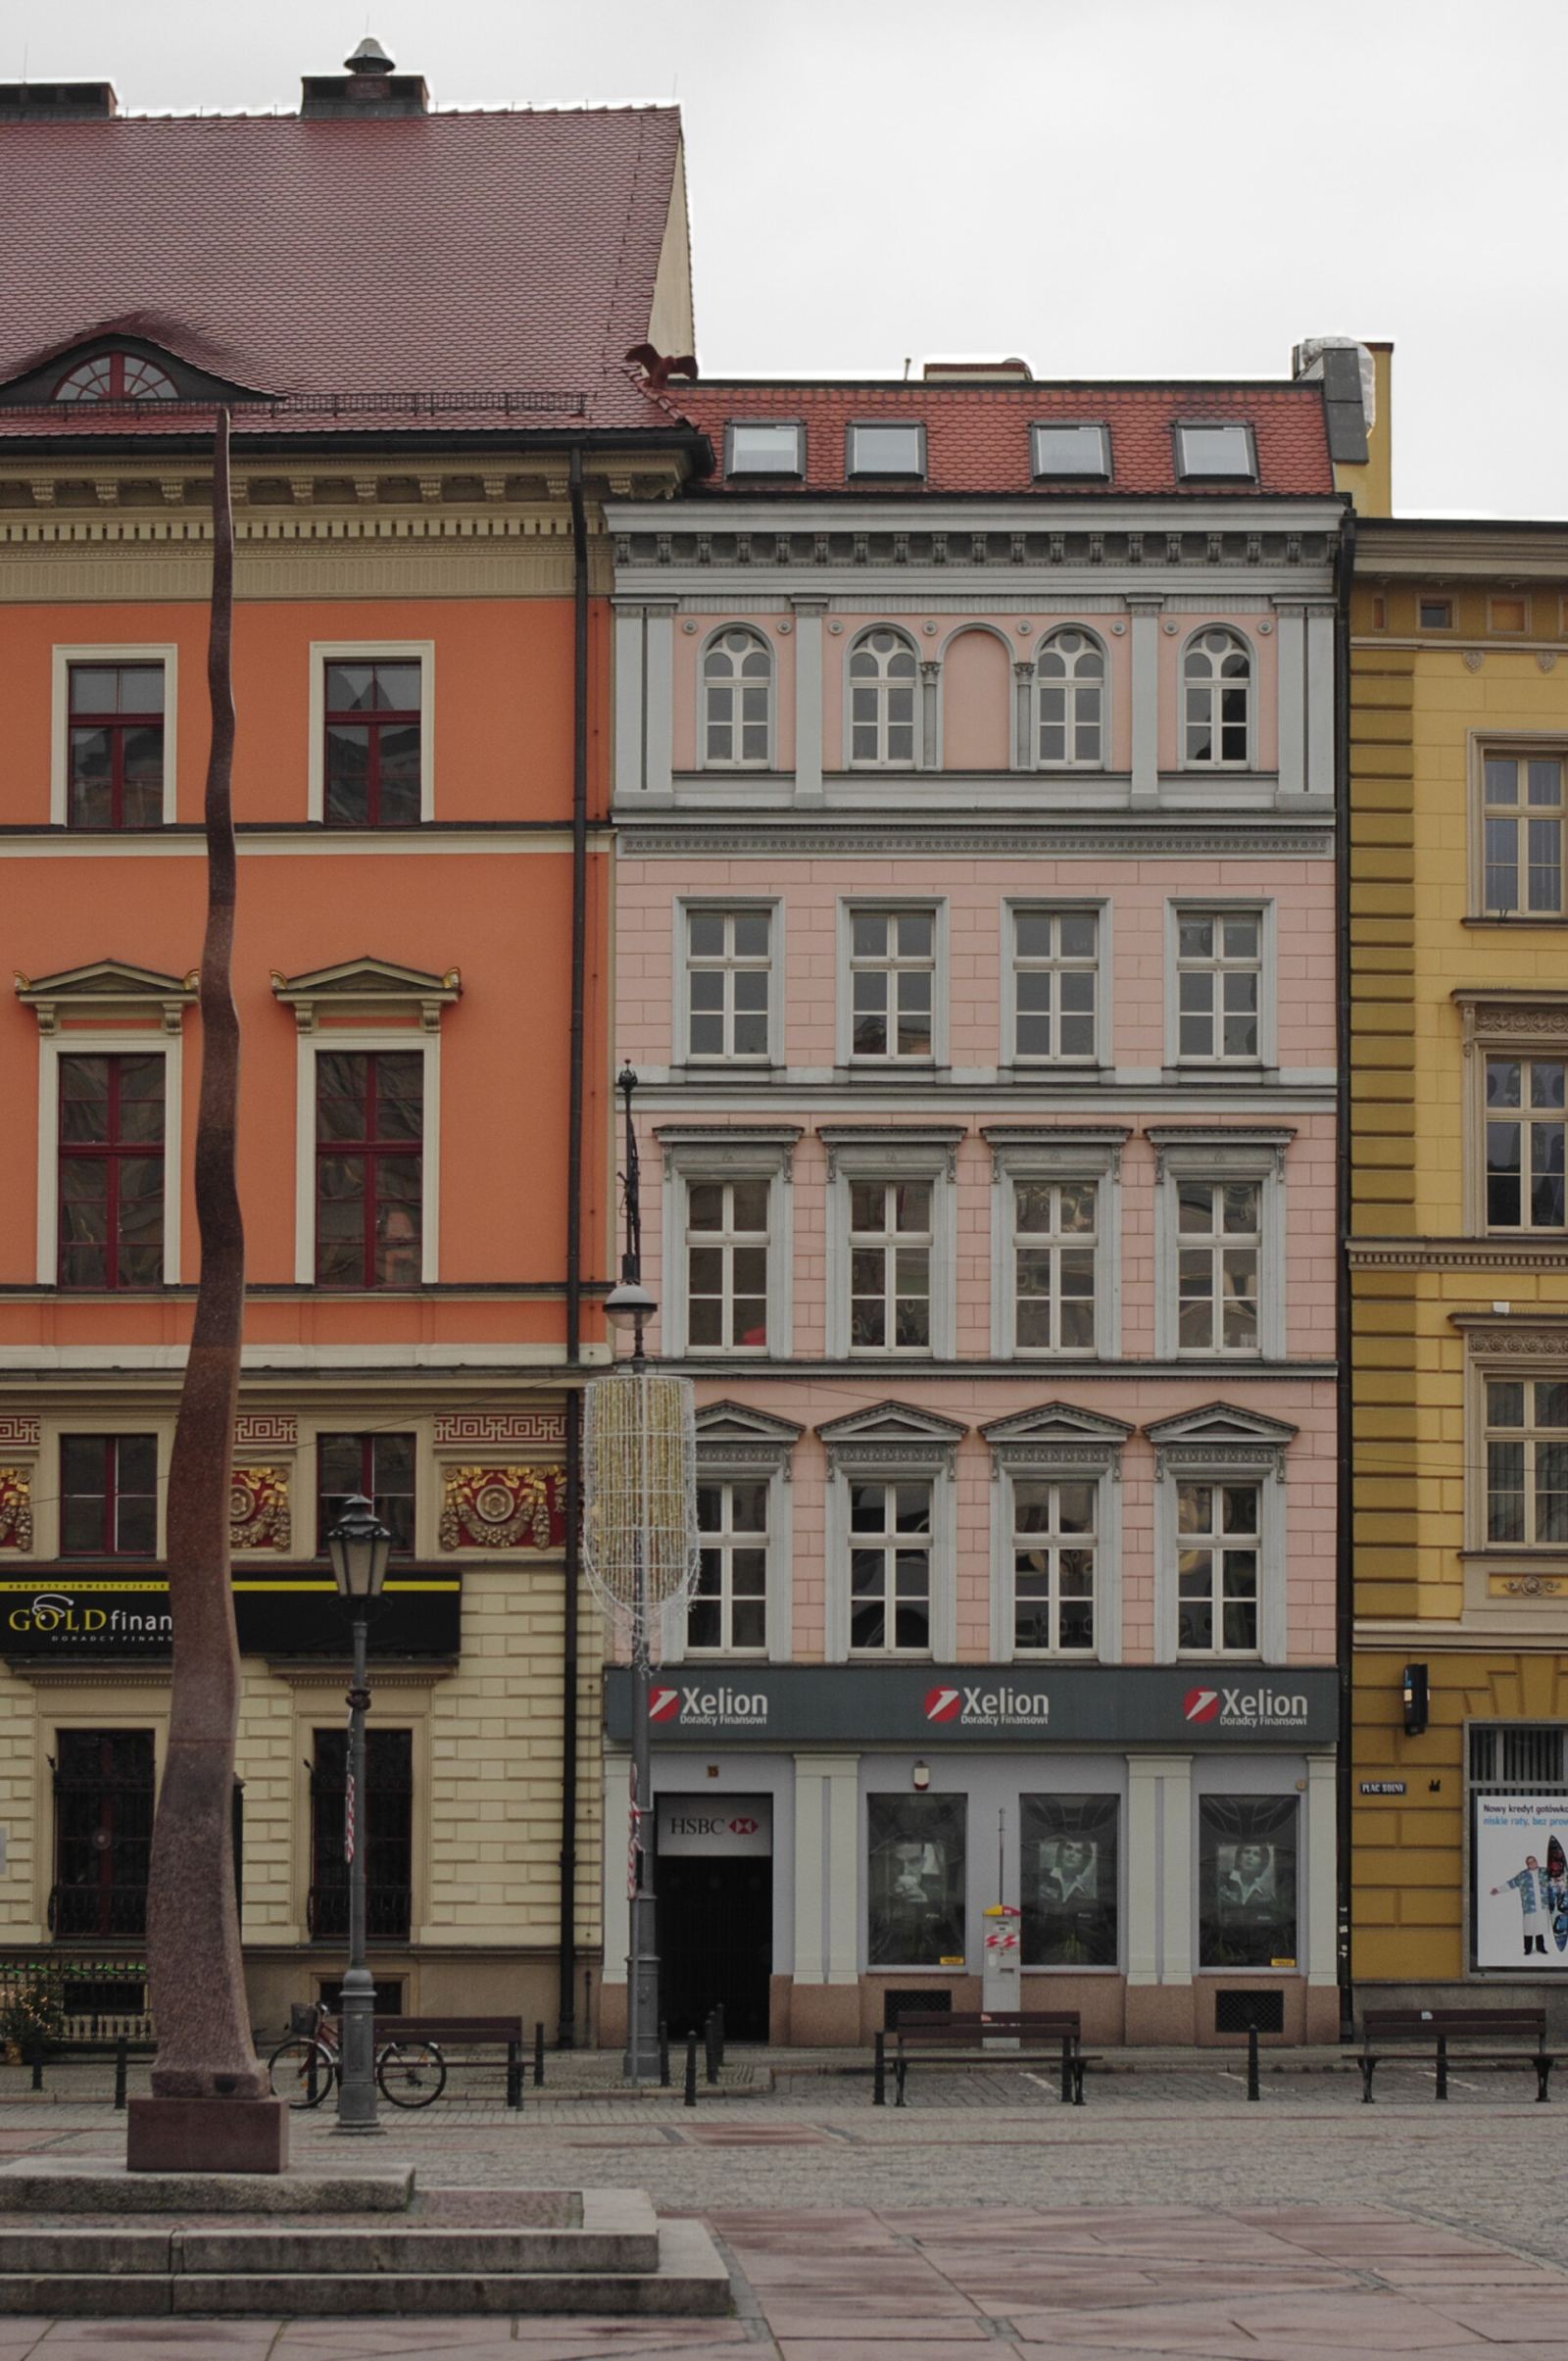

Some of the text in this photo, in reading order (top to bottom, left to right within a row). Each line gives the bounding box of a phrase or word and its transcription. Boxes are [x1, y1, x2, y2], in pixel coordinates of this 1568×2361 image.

[681, 1687, 768, 1715] Xelion
[962, 1687, 1050, 1715] Xelion
[1221, 1688, 1308, 1716] Xelion
[680, 1714, 767, 1726] Doradcy Finansowi
[960, 1714, 1049, 1726] Doradcy Finansowi
[1219, 1715, 1307, 1728] Doradcy Finansowi
[1484, 1804, 1506, 1815] Nowy
[1508, 1803, 1534, 1815] kredyt
[670, 1817, 725, 1835] HSBC
